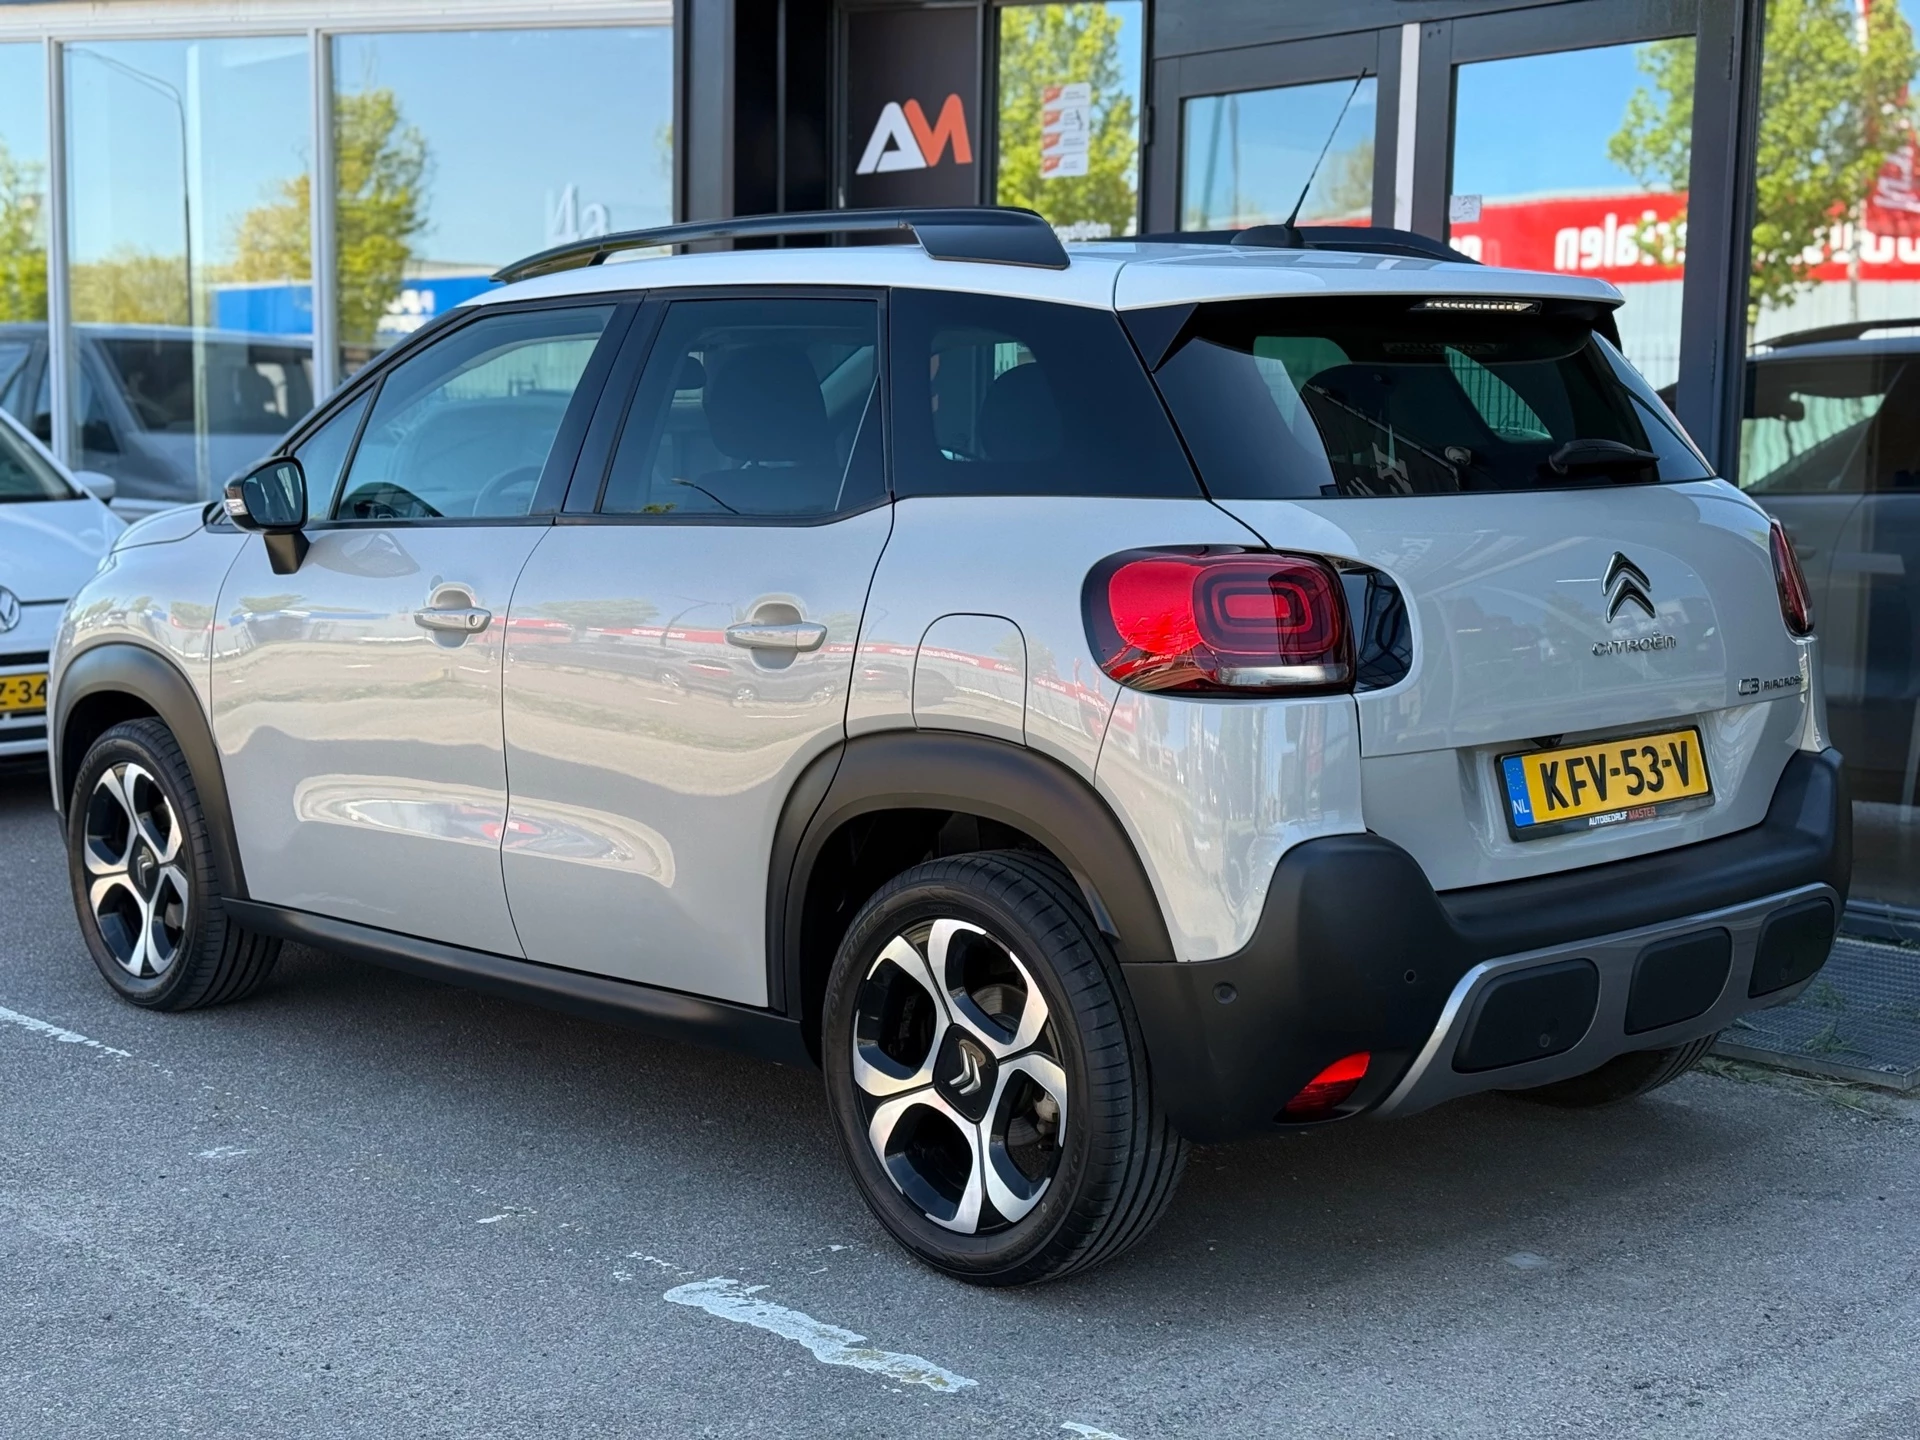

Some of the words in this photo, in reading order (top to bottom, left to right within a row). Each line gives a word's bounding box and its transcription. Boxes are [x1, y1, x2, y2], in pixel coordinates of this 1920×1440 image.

[856, 93, 973, 175] AM
[1738, 678, 1759, 696] C3
[1540, 740, 1690, 811] KFV-53-V
[1512, 799, 1530, 815] NL
[1589, 811, 1628, 826] AUTOBEDRIJF
[1628, 806, 1657, 820] MASTER
